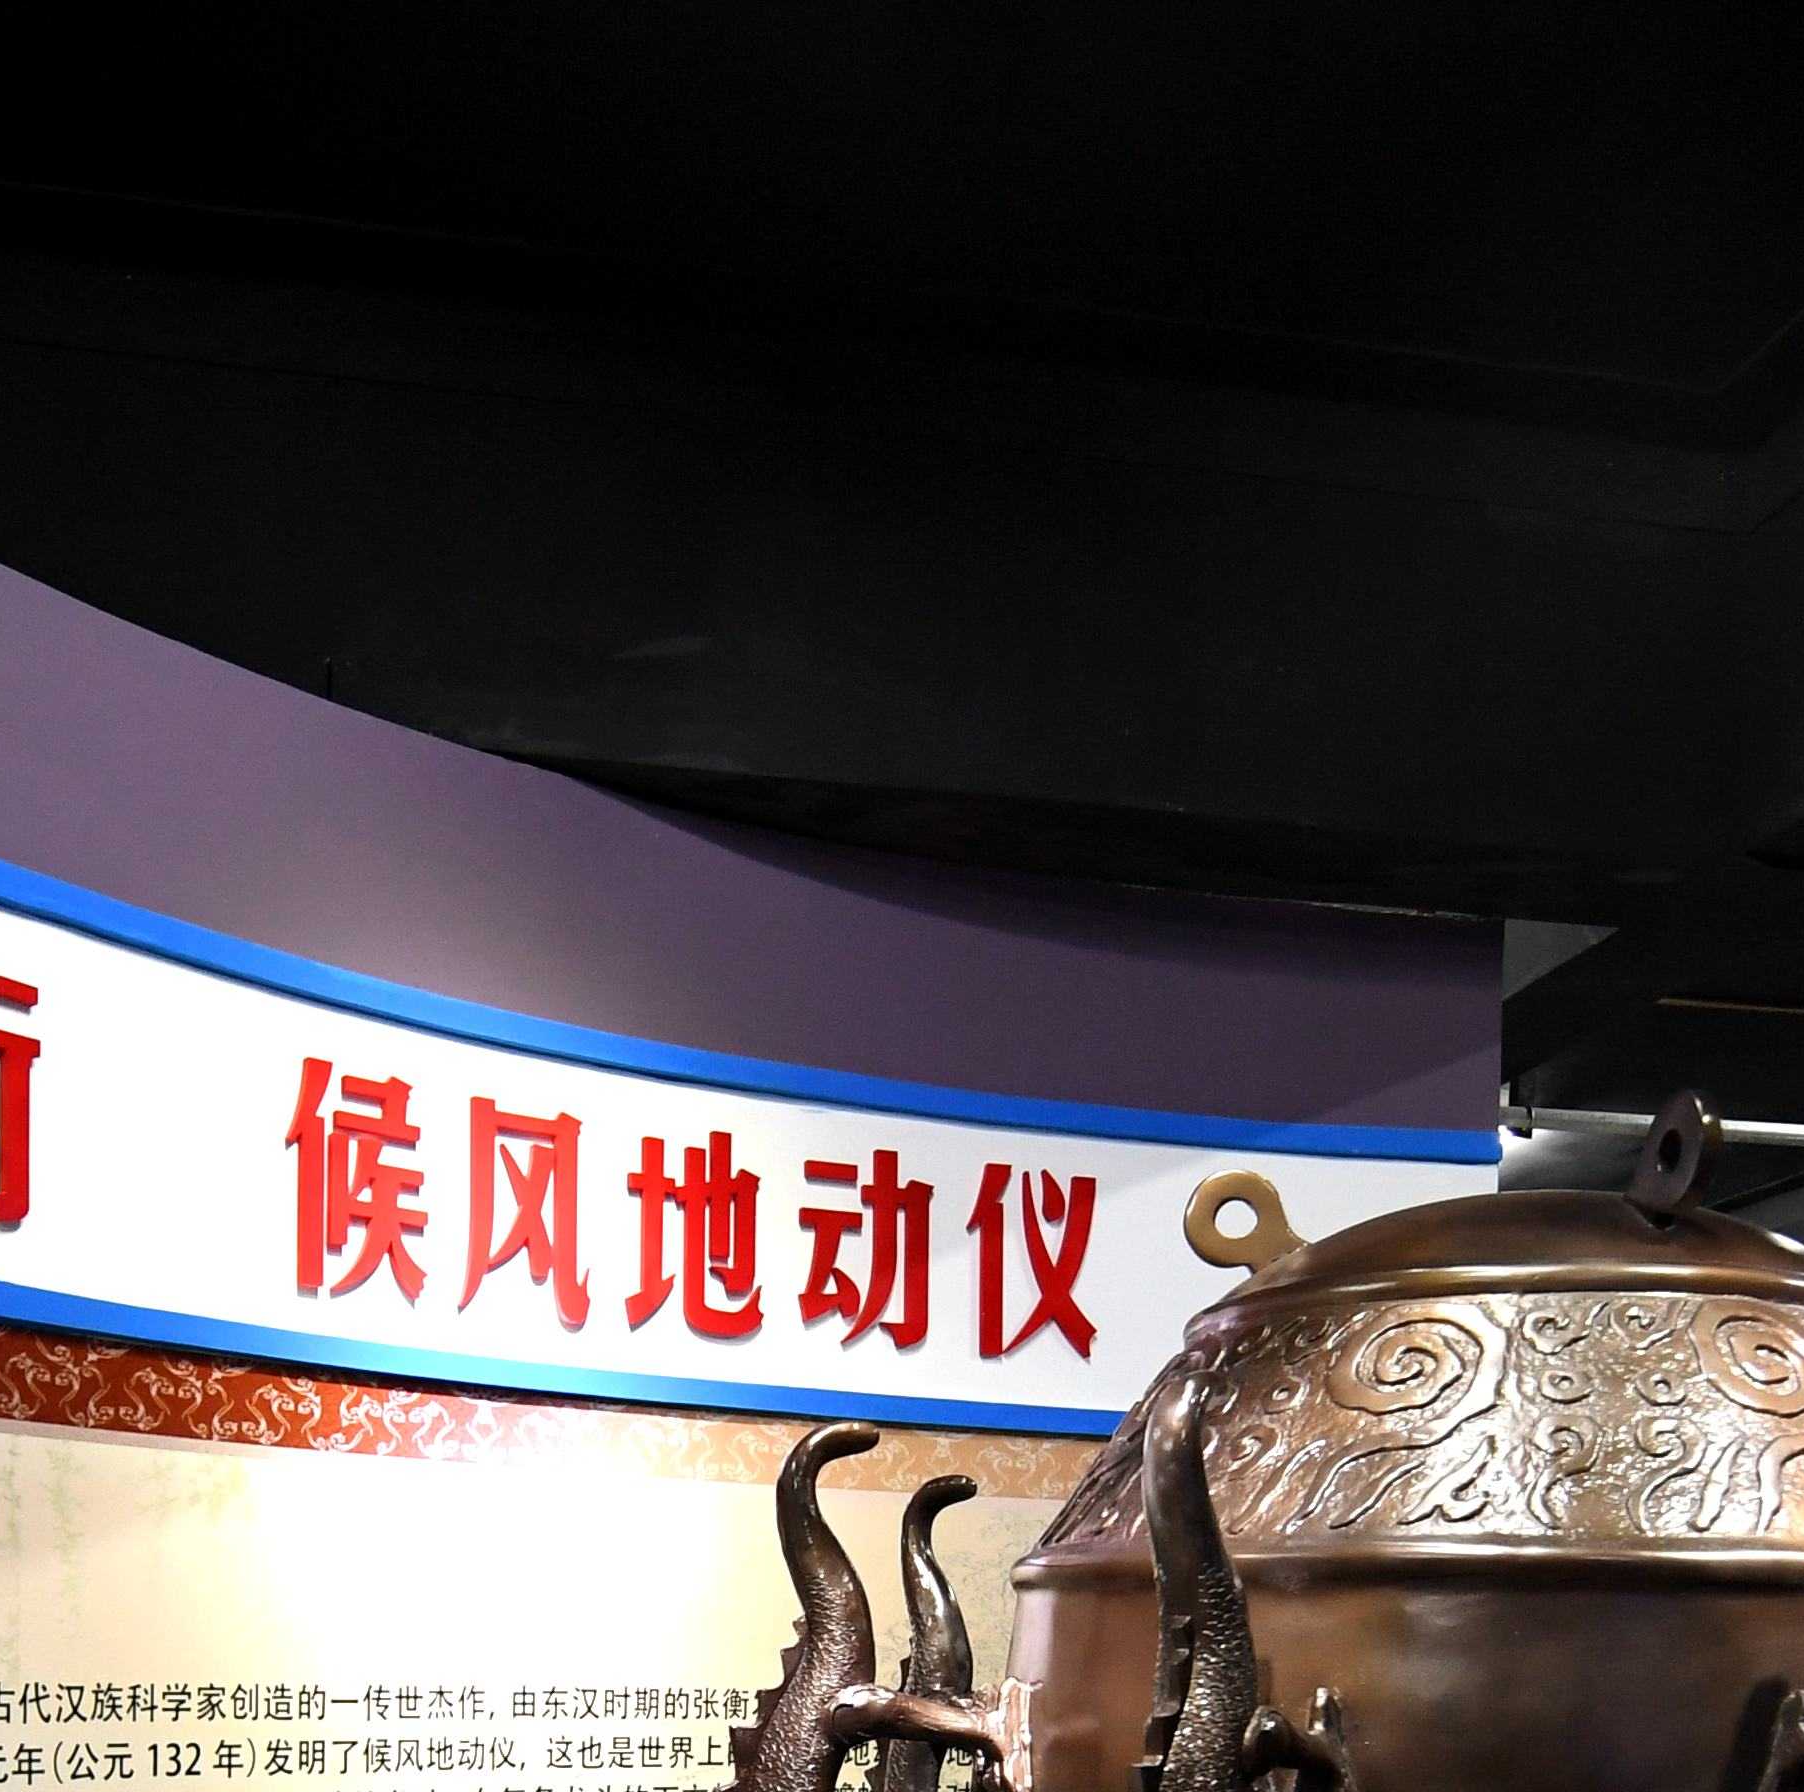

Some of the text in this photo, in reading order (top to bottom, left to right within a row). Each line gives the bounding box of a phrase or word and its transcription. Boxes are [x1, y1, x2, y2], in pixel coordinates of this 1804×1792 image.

[283, 1056, 1098, 1360] 候风地动仪
